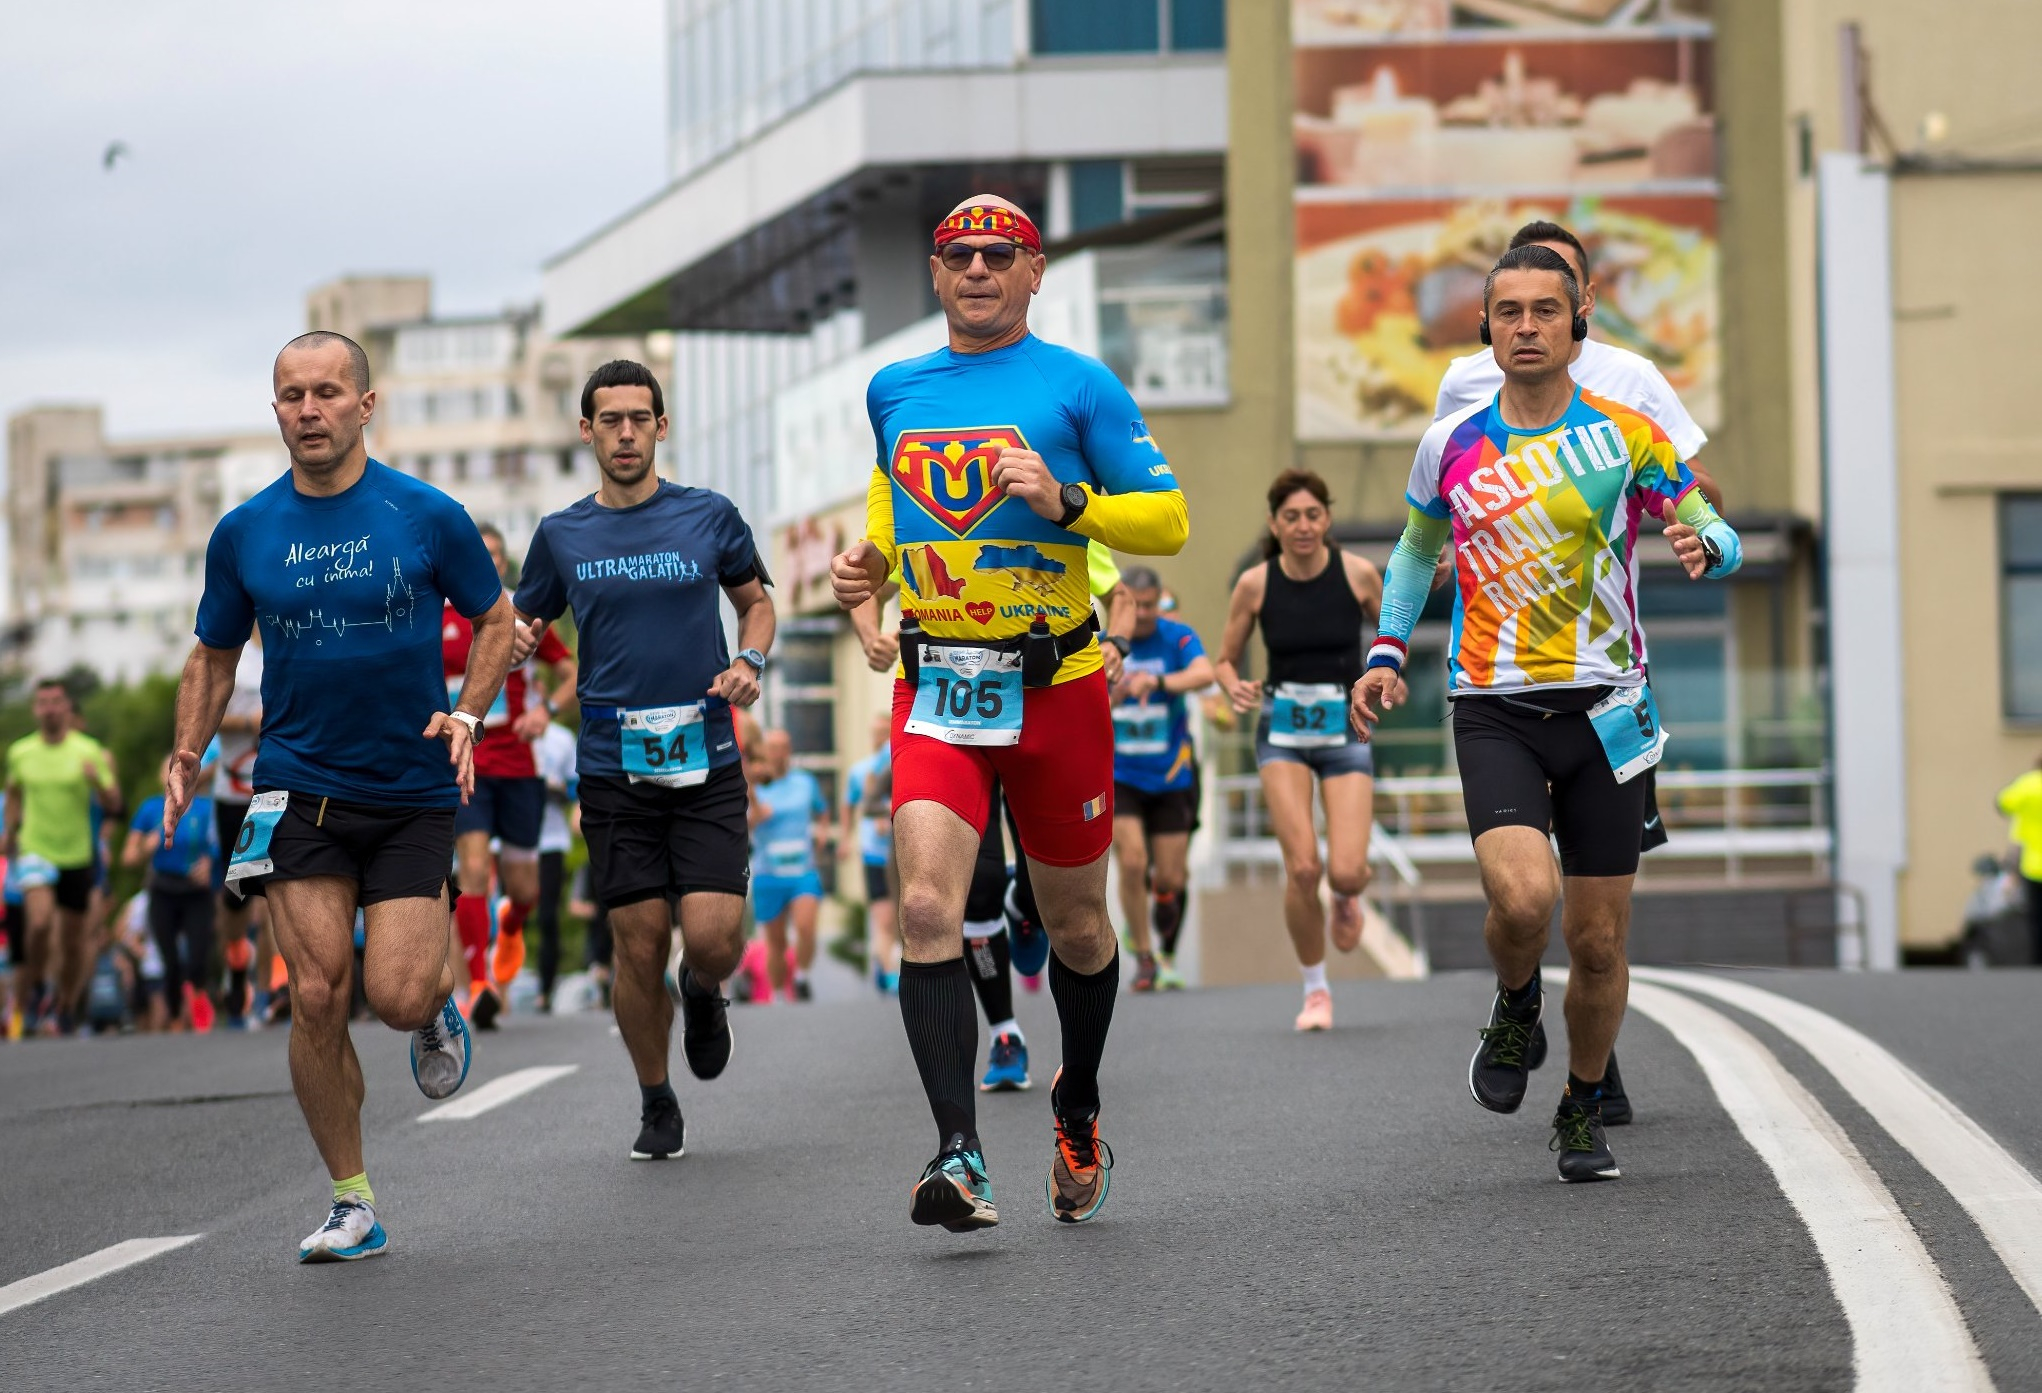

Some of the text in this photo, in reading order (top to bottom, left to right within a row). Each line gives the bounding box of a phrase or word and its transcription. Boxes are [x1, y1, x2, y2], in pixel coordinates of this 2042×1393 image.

[1448, 419, 1631, 528] ASCOTID
[284, 534, 371, 571] Aleargă
[1458, 500, 1575, 582] TRAIL
[576, 557, 629, 581] ULTRA
[628, 551, 680, 567] MARATON
[296, 575, 314, 588] cu
[1482, 551, 1576, 618] RACE
[913, 604, 1071, 622] OMANIA HELP UKRAINE
[934, 678, 1003, 719] 105
[1292, 706, 1326, 730] 52
[643, 734, 688, 767] 54
